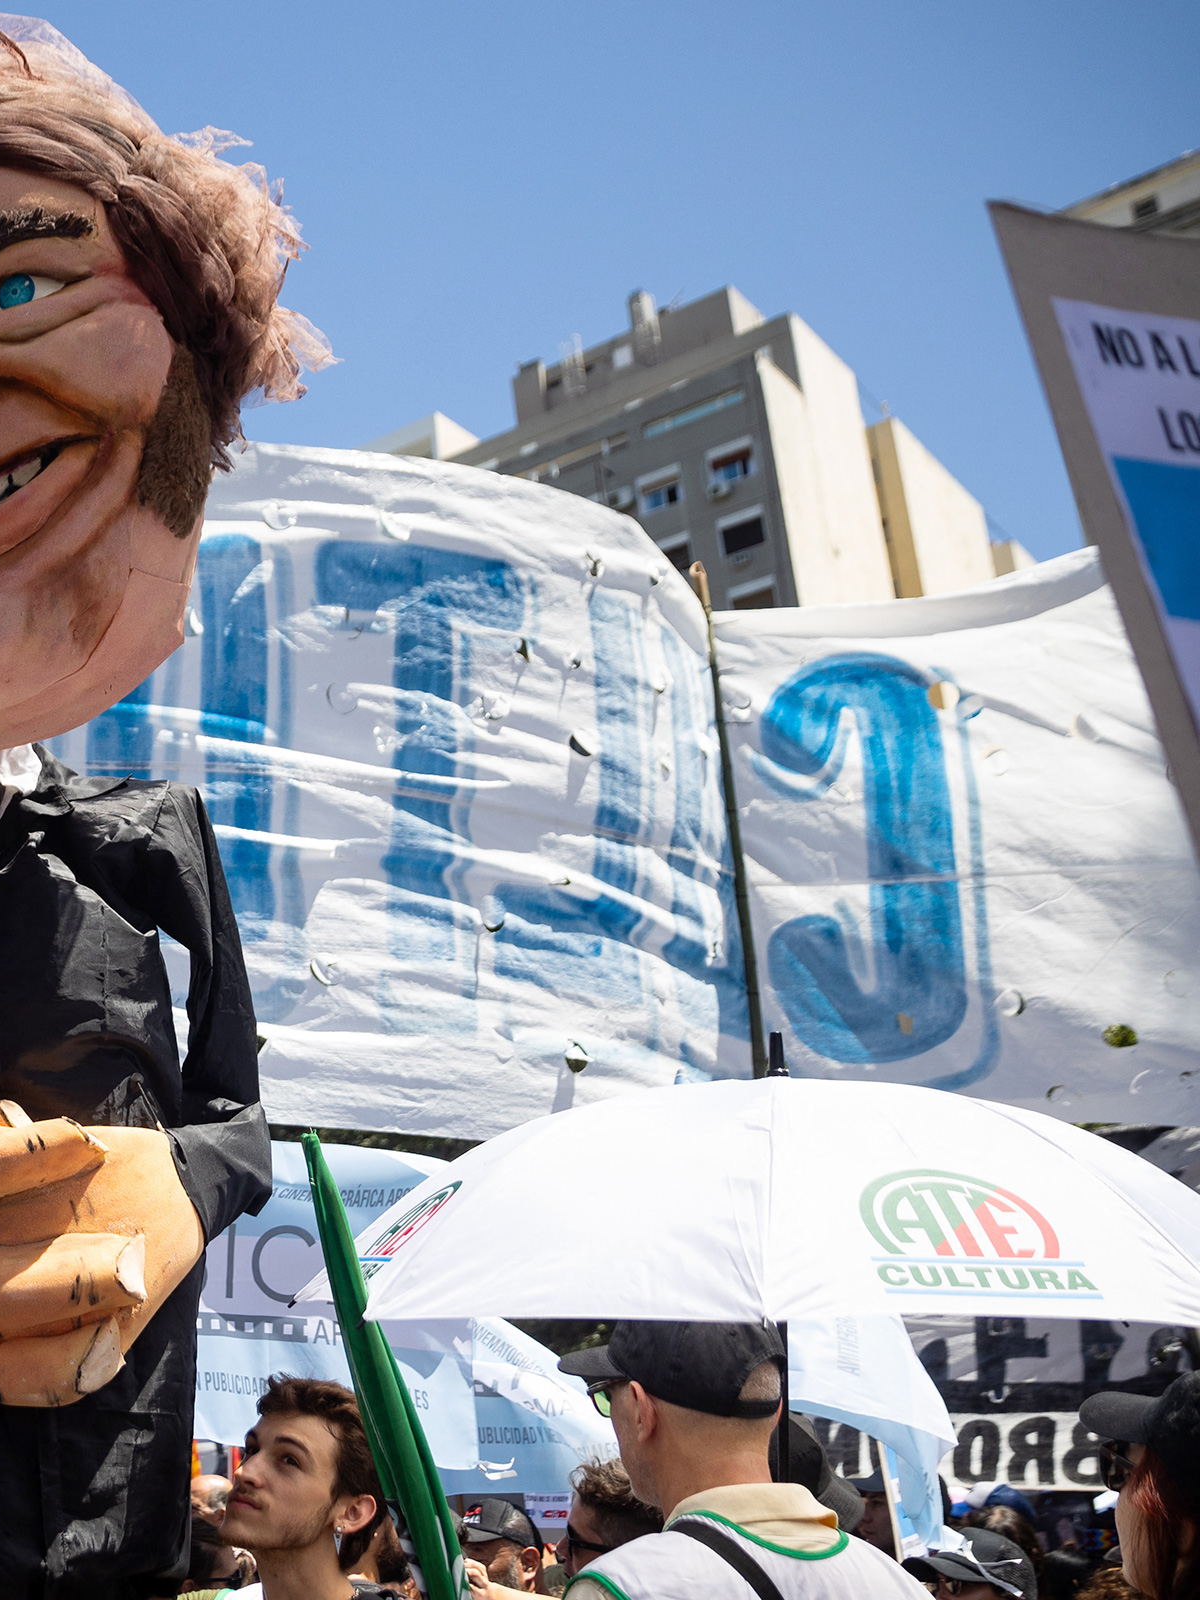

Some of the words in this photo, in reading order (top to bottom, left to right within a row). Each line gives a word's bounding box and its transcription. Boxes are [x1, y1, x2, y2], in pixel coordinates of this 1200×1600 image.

[1091, 321, 1144, 368] NO
[1149, 330, 1178, 374] A
[882, 1182, 1036, 1259] ATE
[877, 1263, 1100, 1292] CULTURA
[478, 1426, 537, 1445] UBLICIDAD
